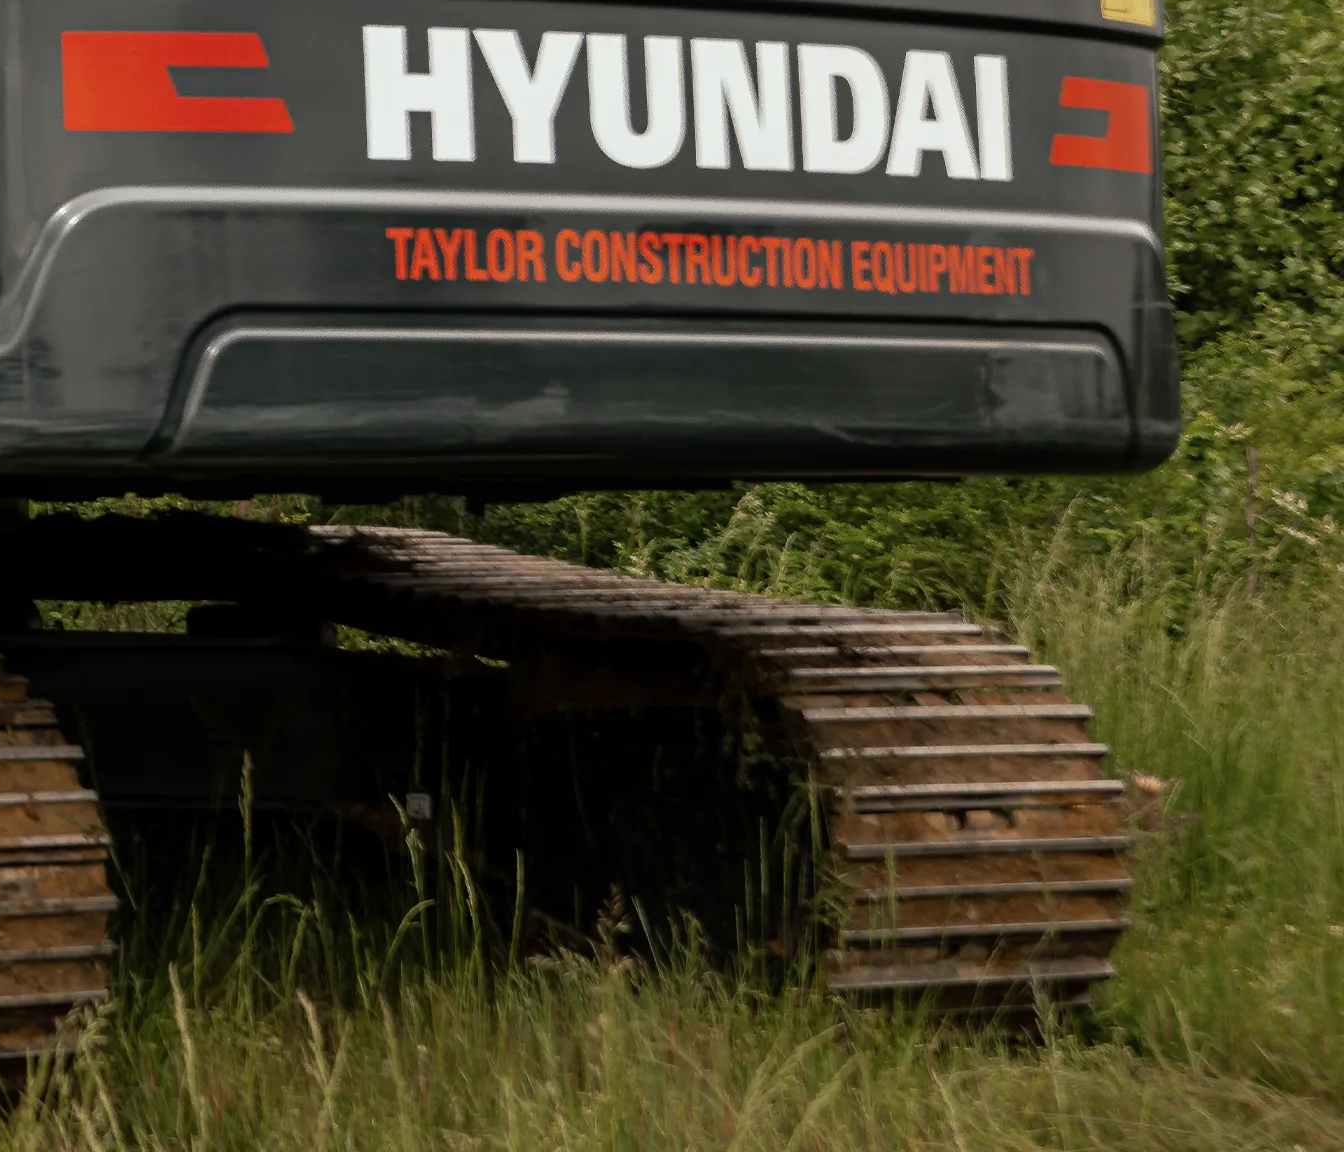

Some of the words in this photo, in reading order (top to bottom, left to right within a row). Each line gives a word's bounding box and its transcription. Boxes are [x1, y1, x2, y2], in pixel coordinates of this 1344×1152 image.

[363, 25, 1012, 181] HYUNDAI
[386, 228, 545, 281] TAYLOR
[556, 229, 842, 288] CONSTRUCTION
[852, 242, 1032, 294] EQUIPMENT
